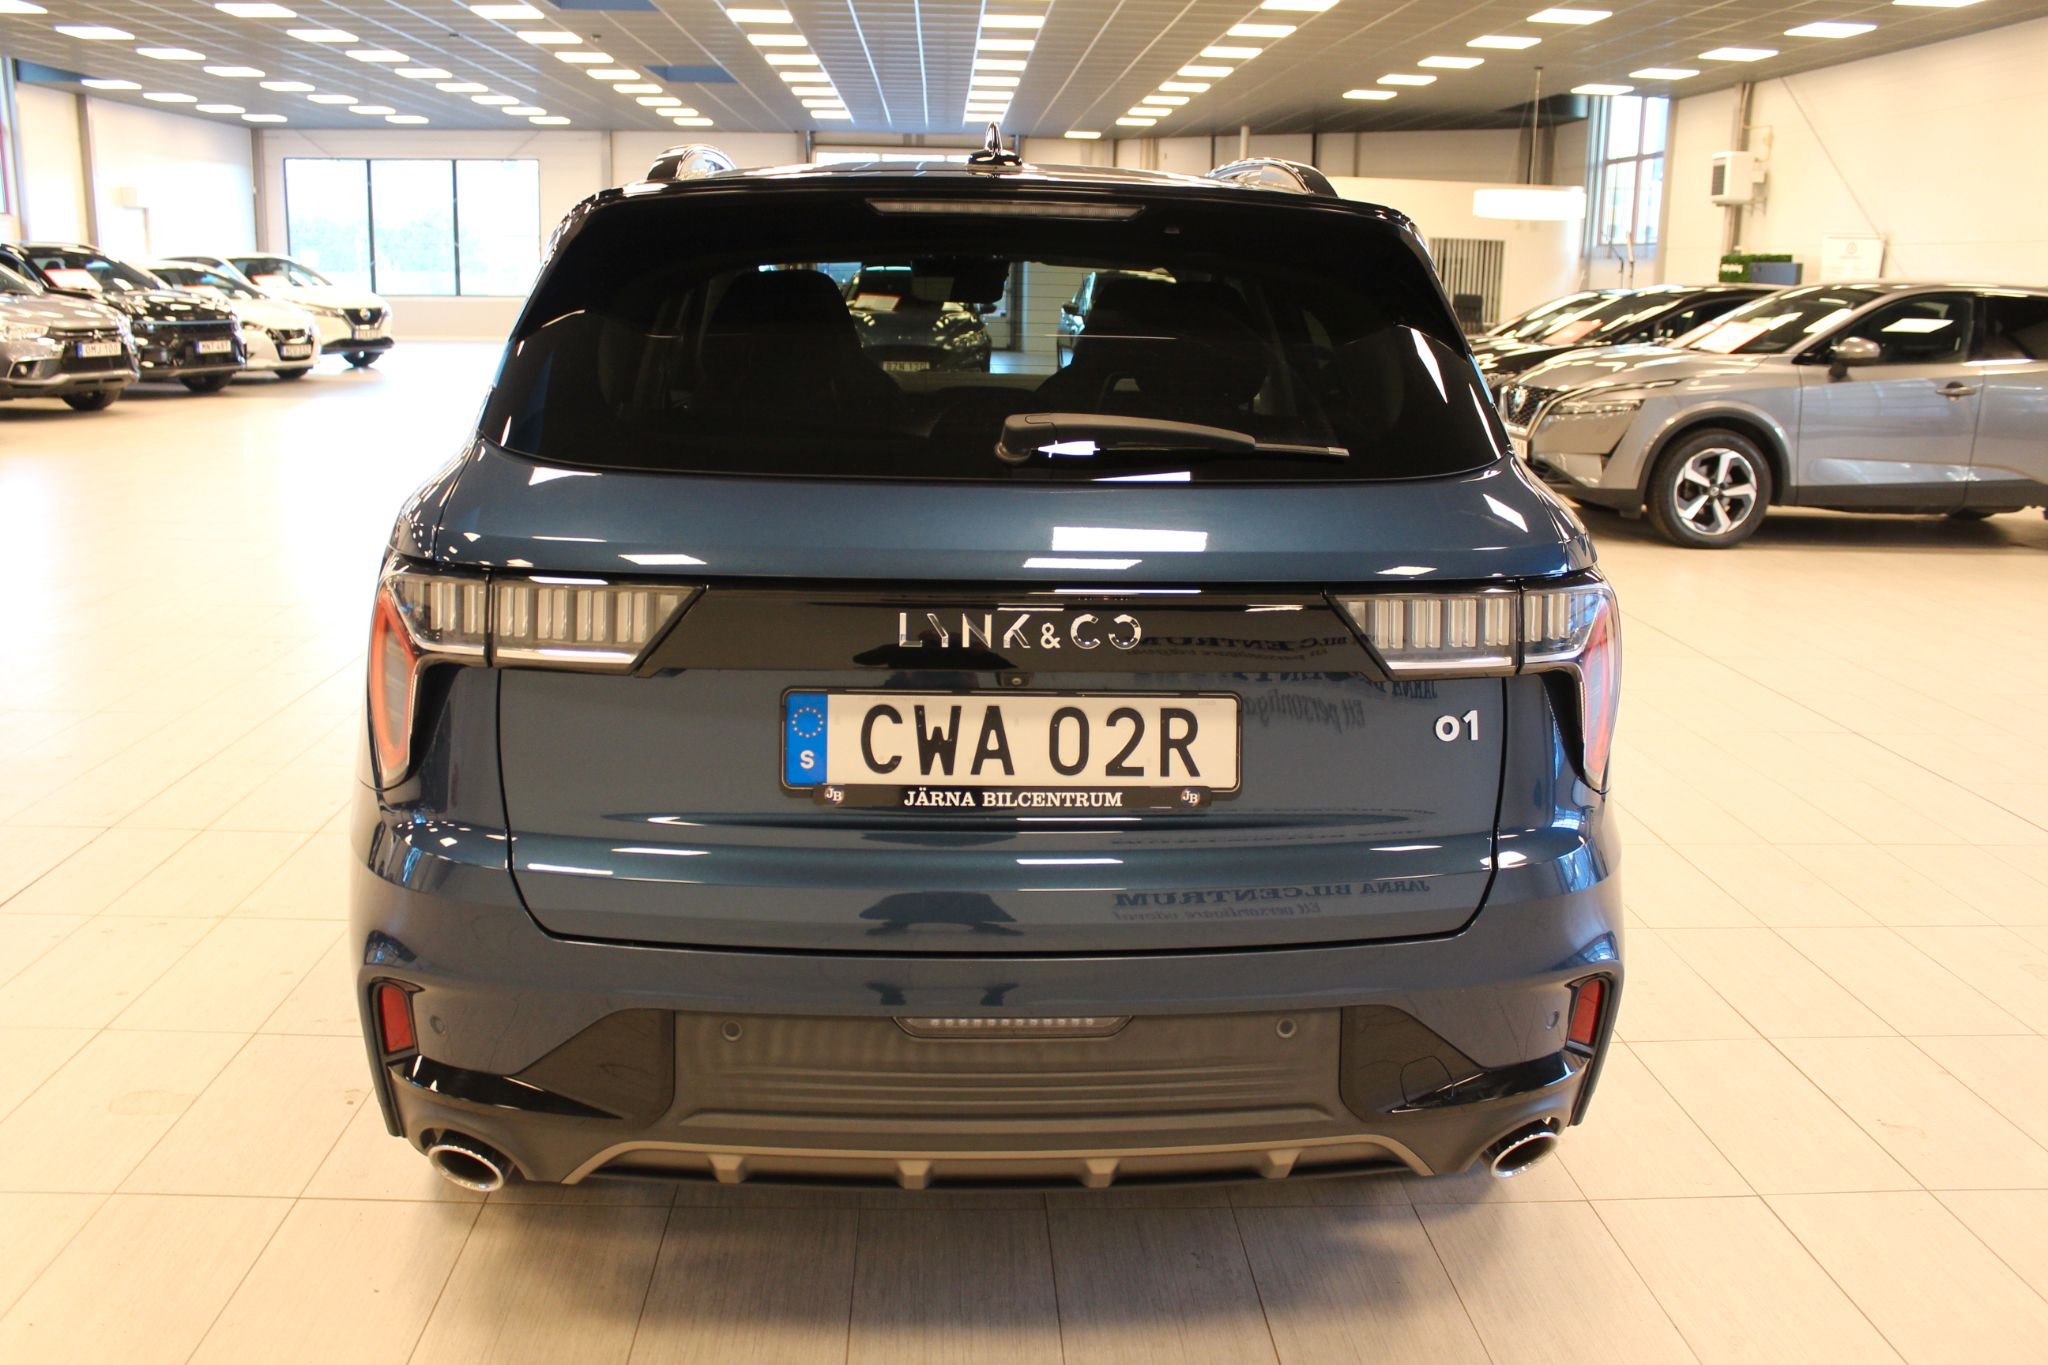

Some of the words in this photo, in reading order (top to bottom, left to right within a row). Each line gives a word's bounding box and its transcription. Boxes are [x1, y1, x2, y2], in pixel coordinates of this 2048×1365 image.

[860, 704, 1015, 776] CWA
[1048, 706, 1201, 778] 02R
[800, 750, 815, 769] S
[904, 787, 977, 807] JÄRNA
[982, 791, 1123, 808] BILCENTRUM
